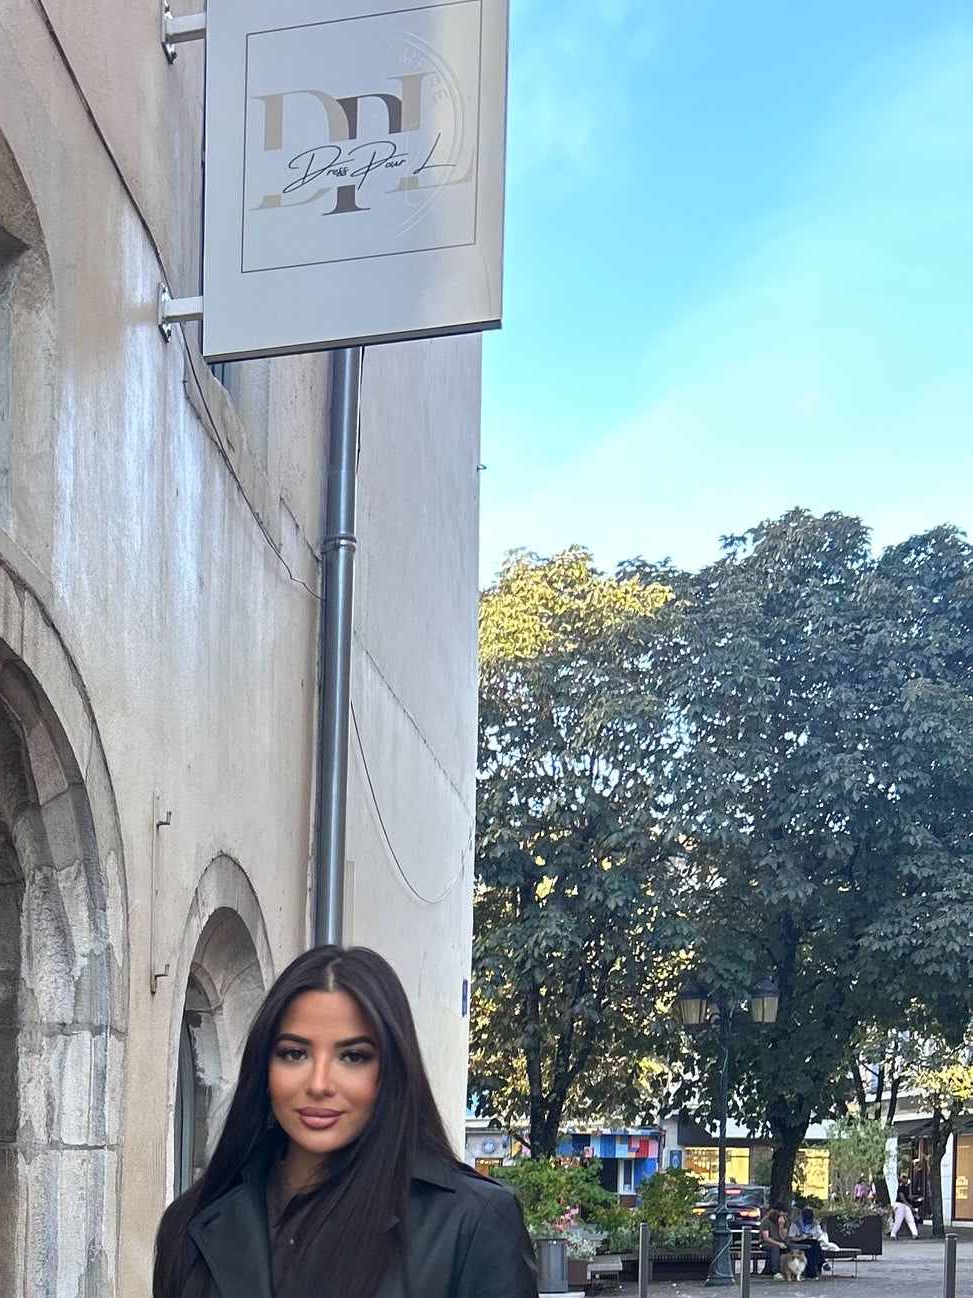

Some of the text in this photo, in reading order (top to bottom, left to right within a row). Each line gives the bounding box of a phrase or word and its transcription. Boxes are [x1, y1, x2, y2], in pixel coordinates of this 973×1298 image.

[283, 133, 457, 193] Dress Pour L
